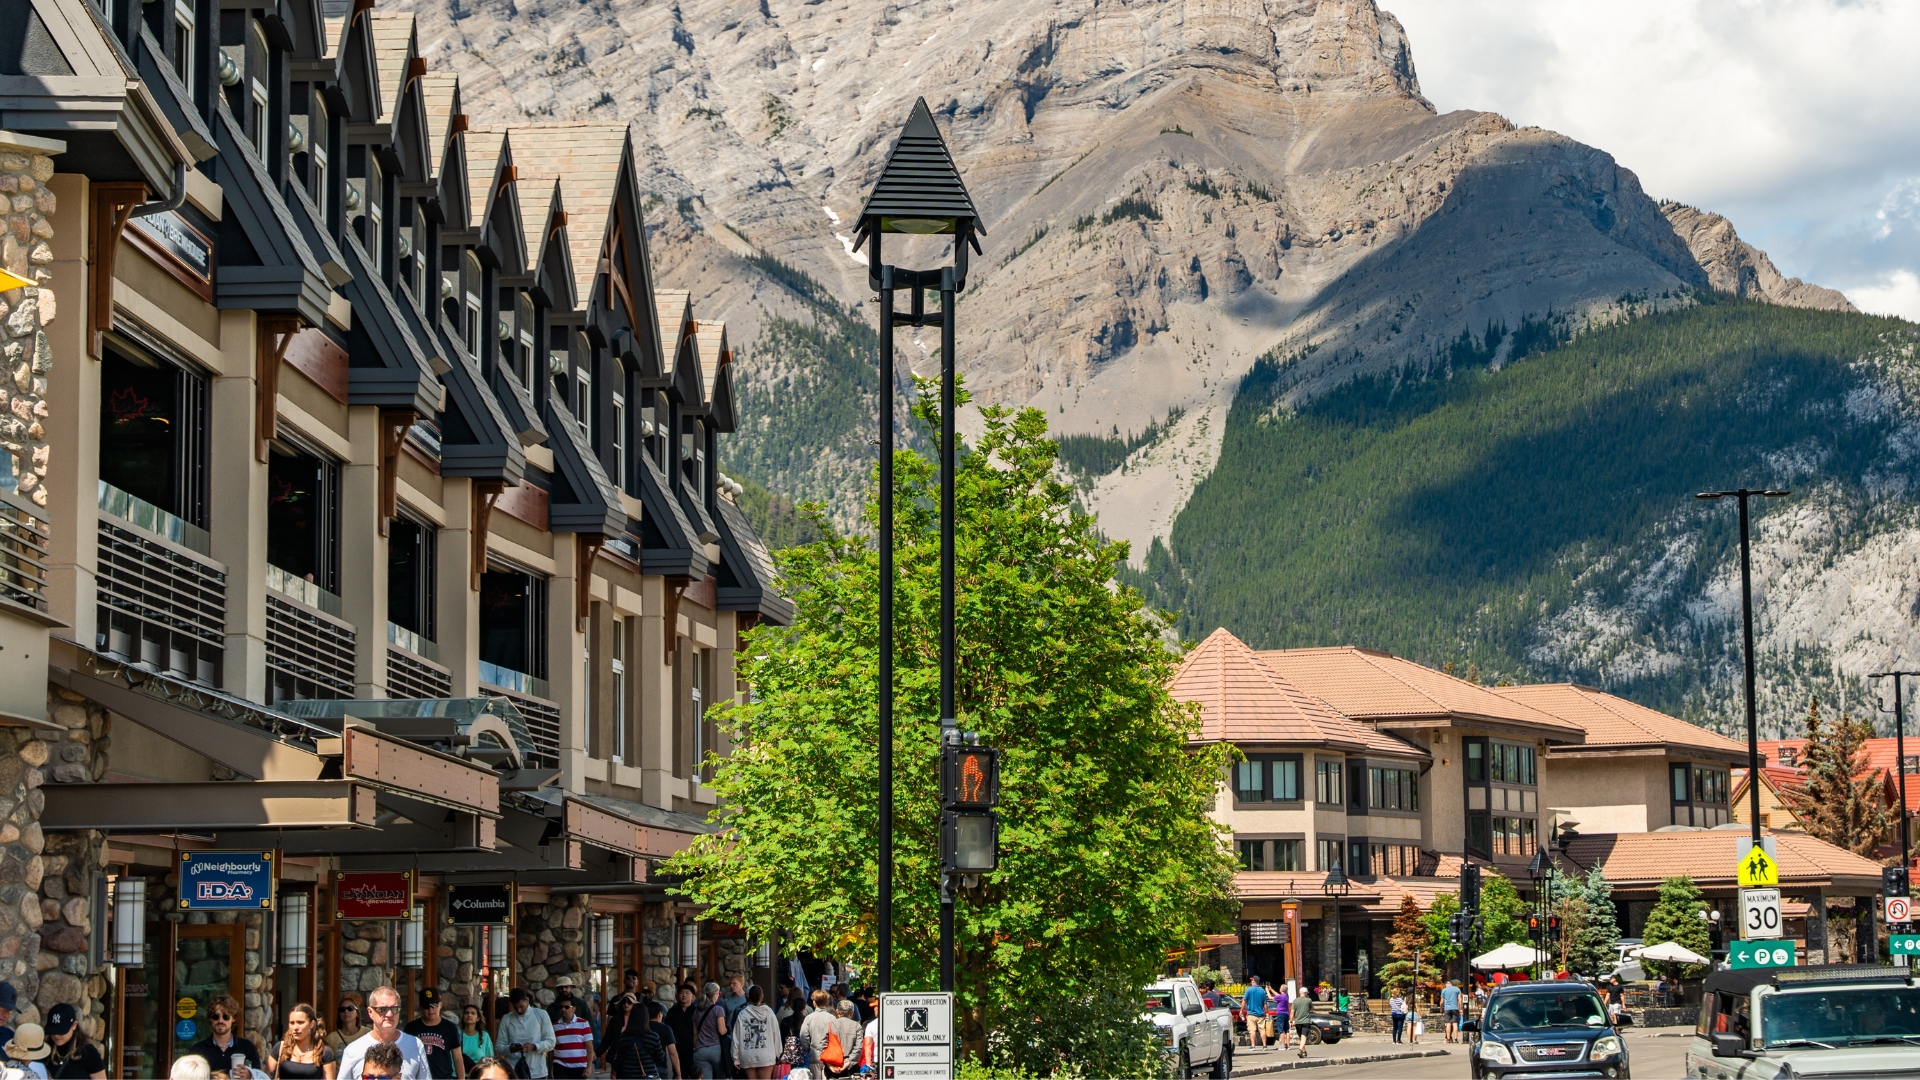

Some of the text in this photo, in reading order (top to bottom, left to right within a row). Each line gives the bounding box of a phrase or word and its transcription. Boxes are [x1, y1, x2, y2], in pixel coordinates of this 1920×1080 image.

[203, 862, 261, 872] Neighbourly
[341, 890, 405, 899] CANADIAN
[462, 899, 506, 908] Columbia
[1748, 906, 1778, 930] 30
[1759, 951, 1767, 962] P
[1537, 1047, 1566, 1056] GMC
